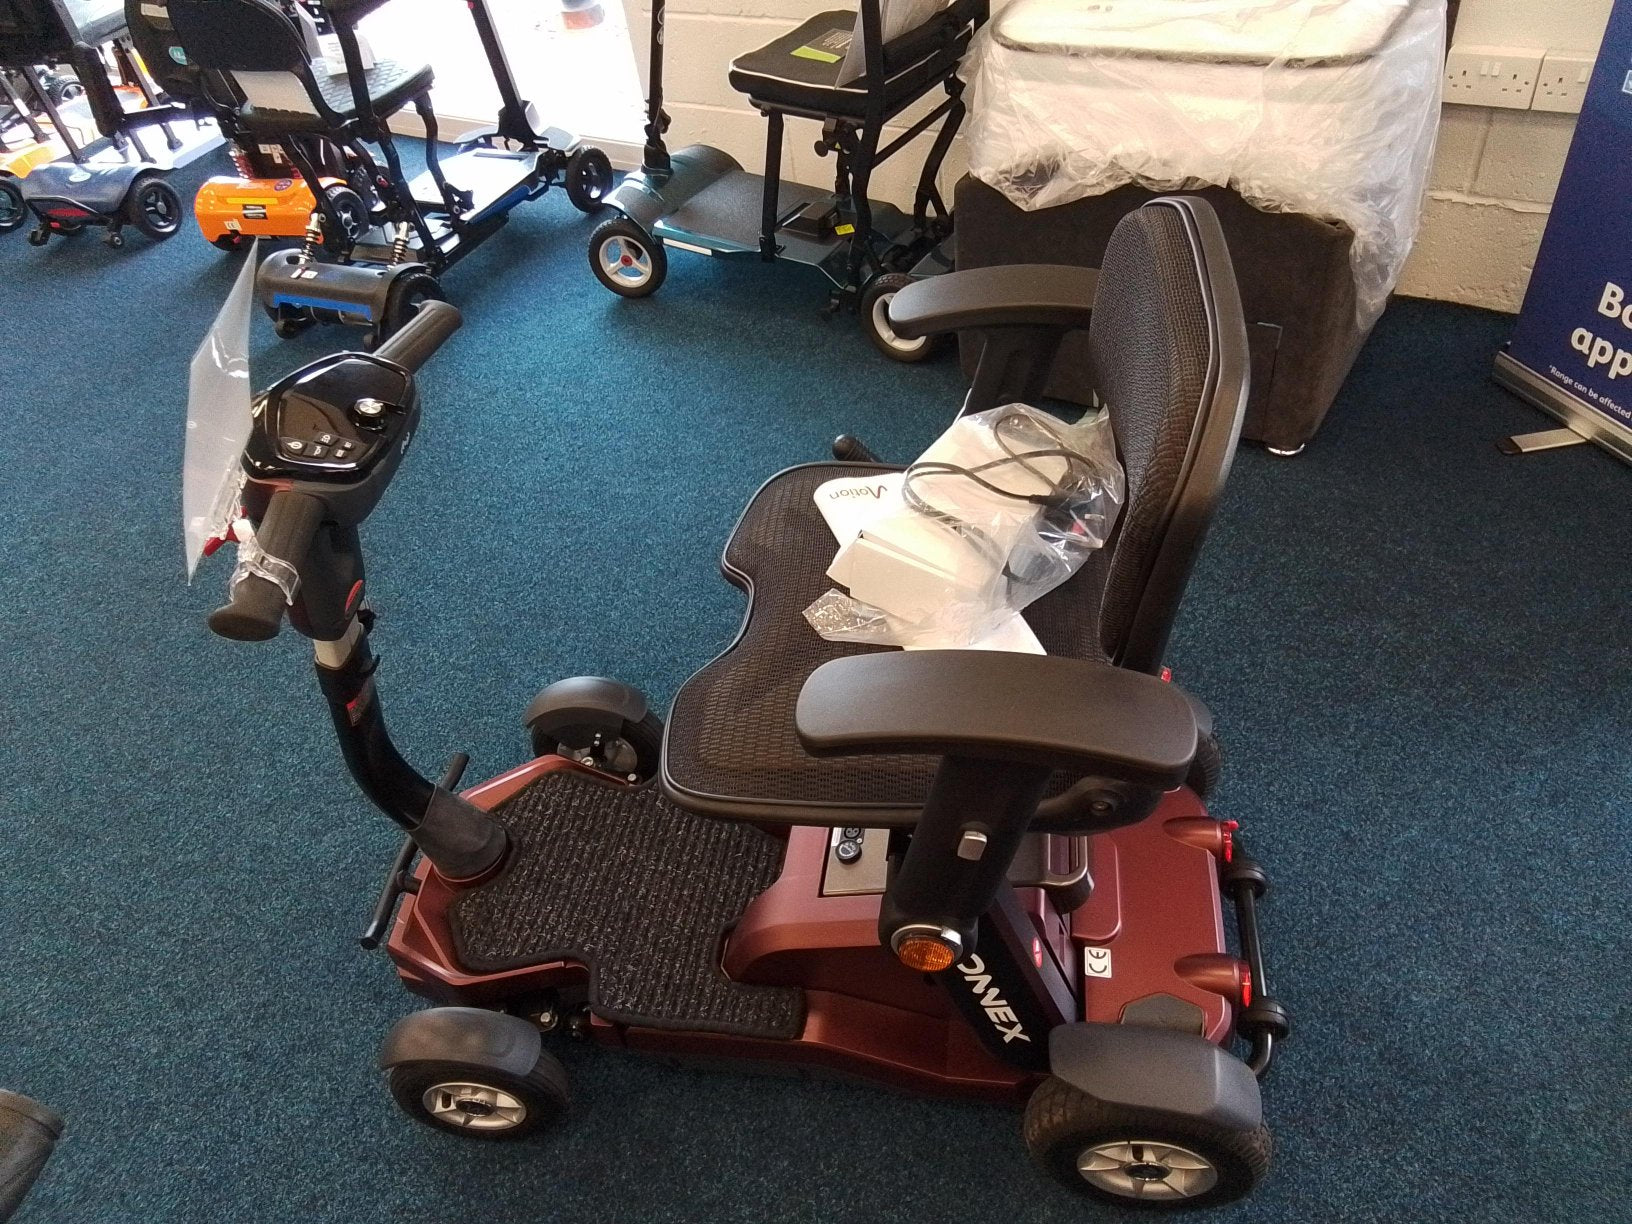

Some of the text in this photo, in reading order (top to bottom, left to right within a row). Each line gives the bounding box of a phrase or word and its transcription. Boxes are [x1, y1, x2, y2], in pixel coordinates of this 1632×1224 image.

[1574, 381, 1588, 394] can
[1588, 388, 1599, 400] be
[1599, 396, 1631, 419] affected
